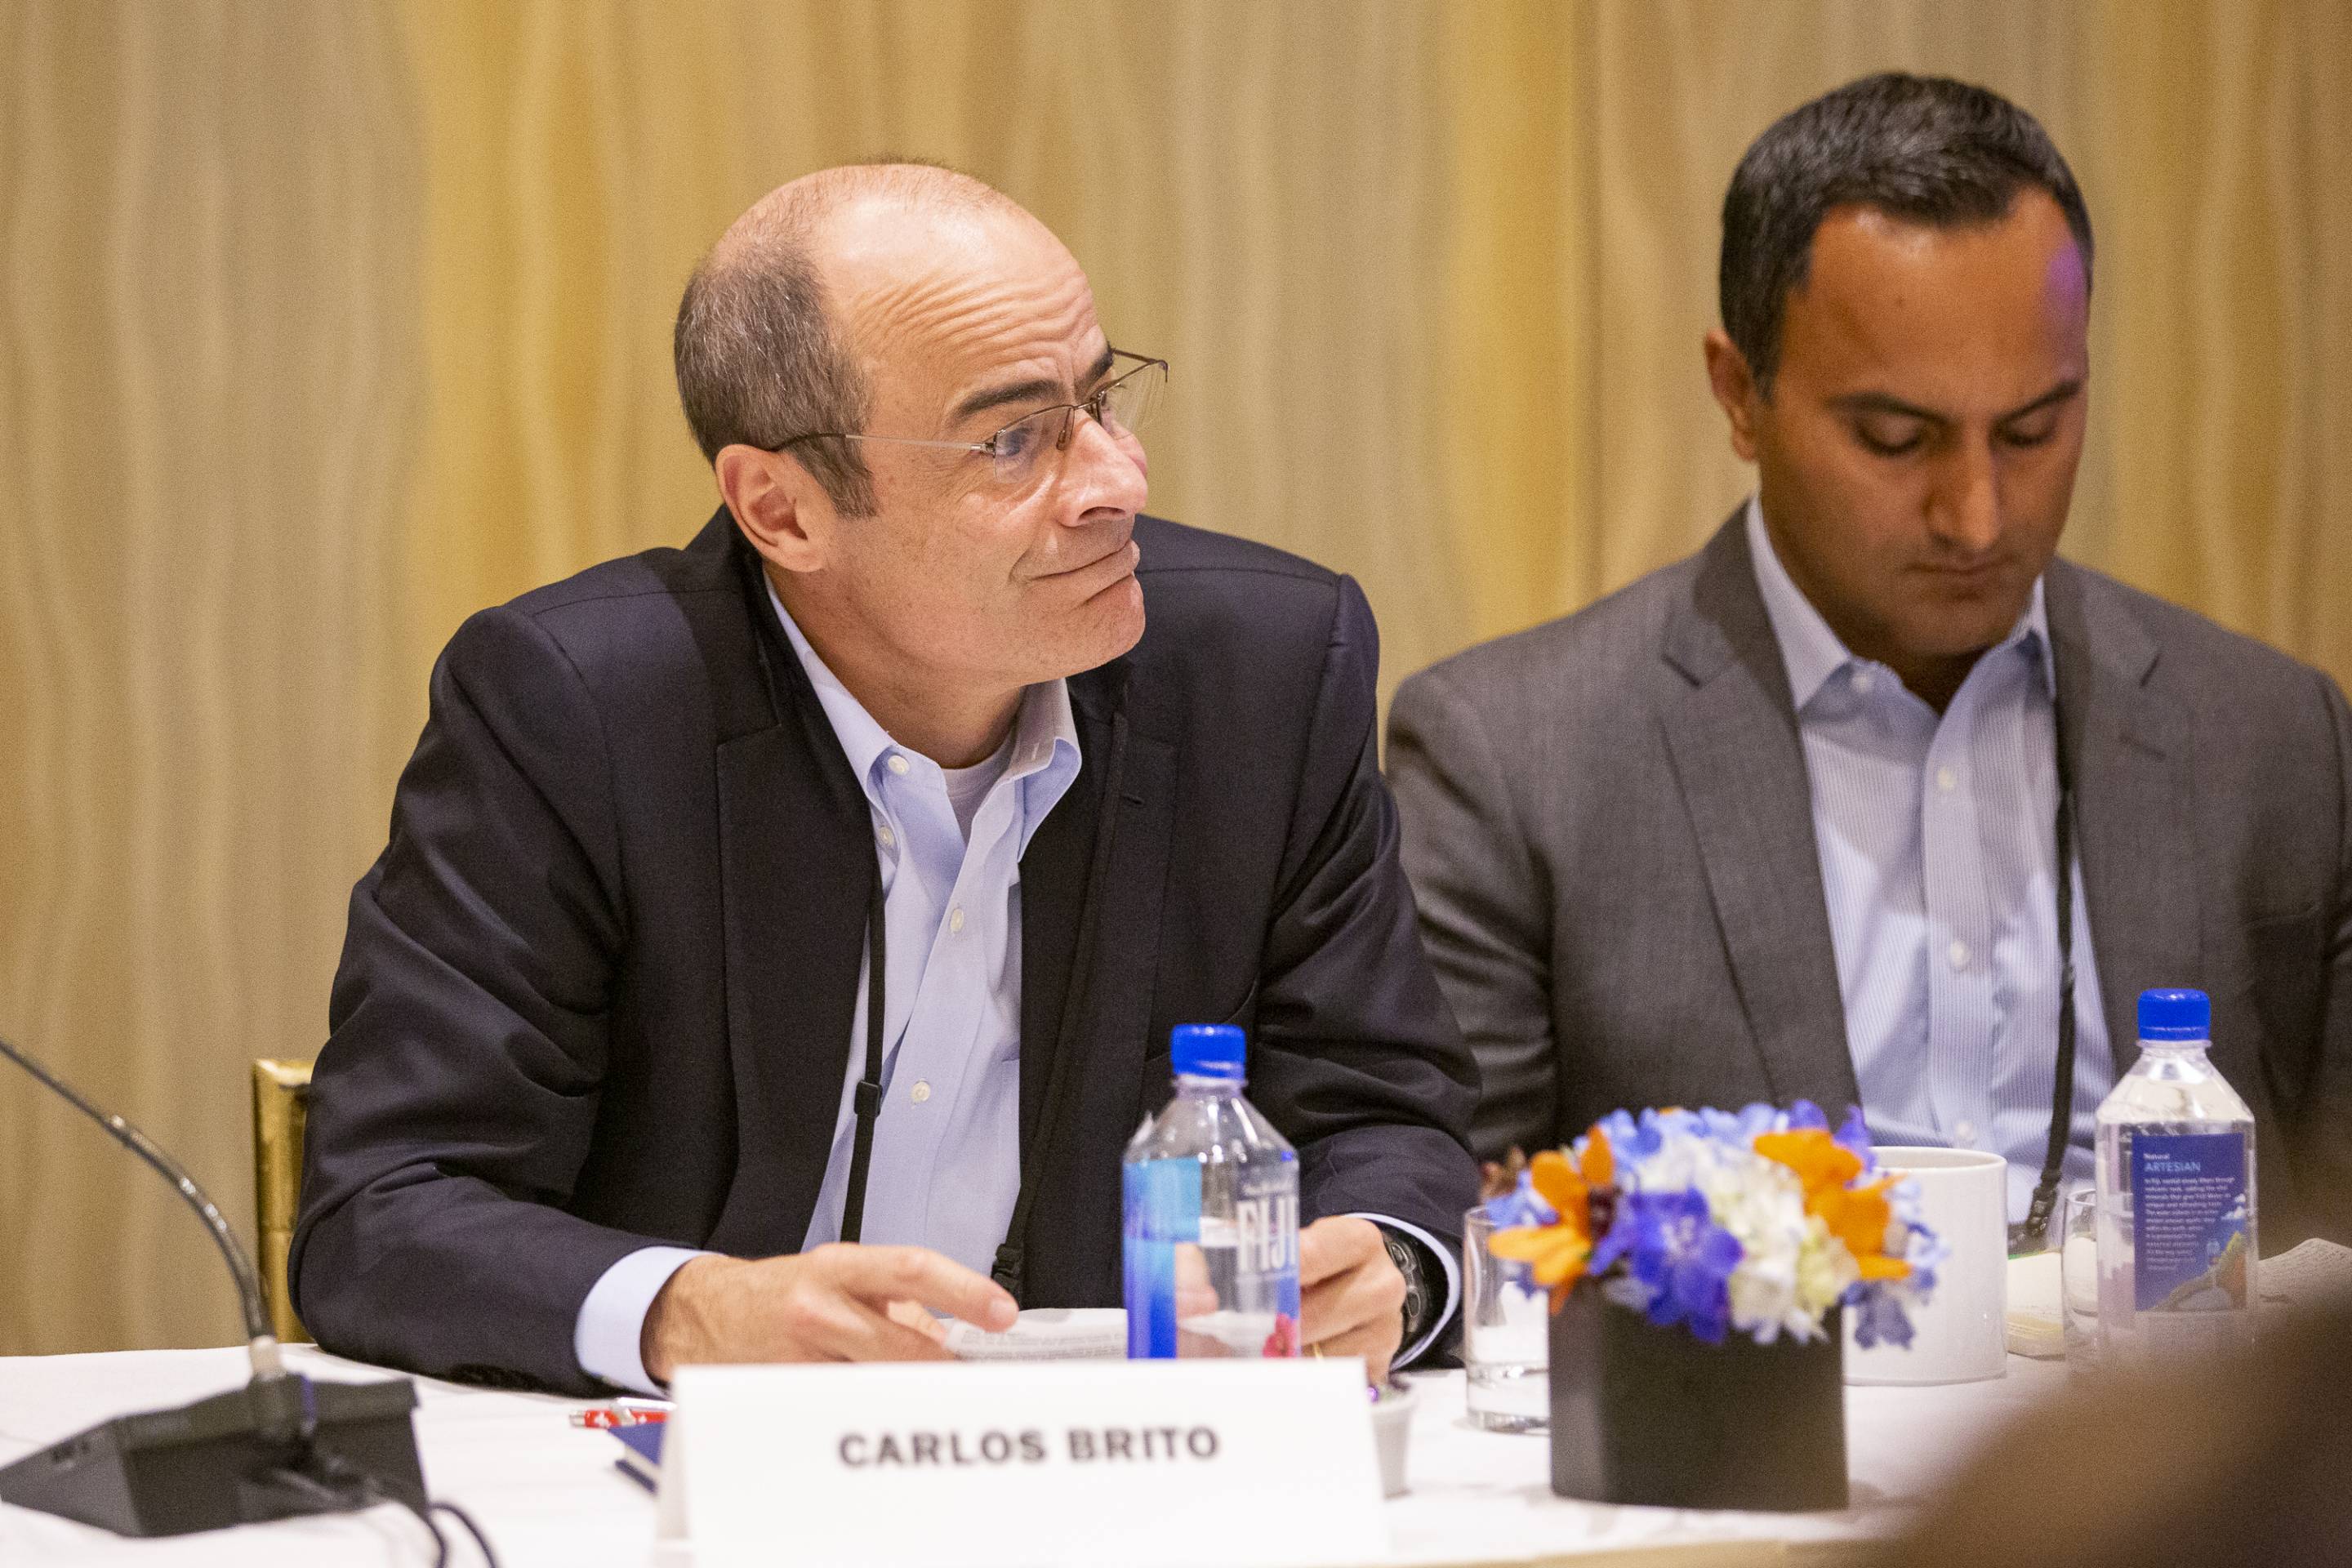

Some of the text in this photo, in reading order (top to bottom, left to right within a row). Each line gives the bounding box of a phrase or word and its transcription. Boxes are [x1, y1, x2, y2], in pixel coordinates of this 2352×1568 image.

[2145, 1161, 2201, 1173] ARTESIAN
[838, 1426, 1218, 1467] CARLOS BRITO
